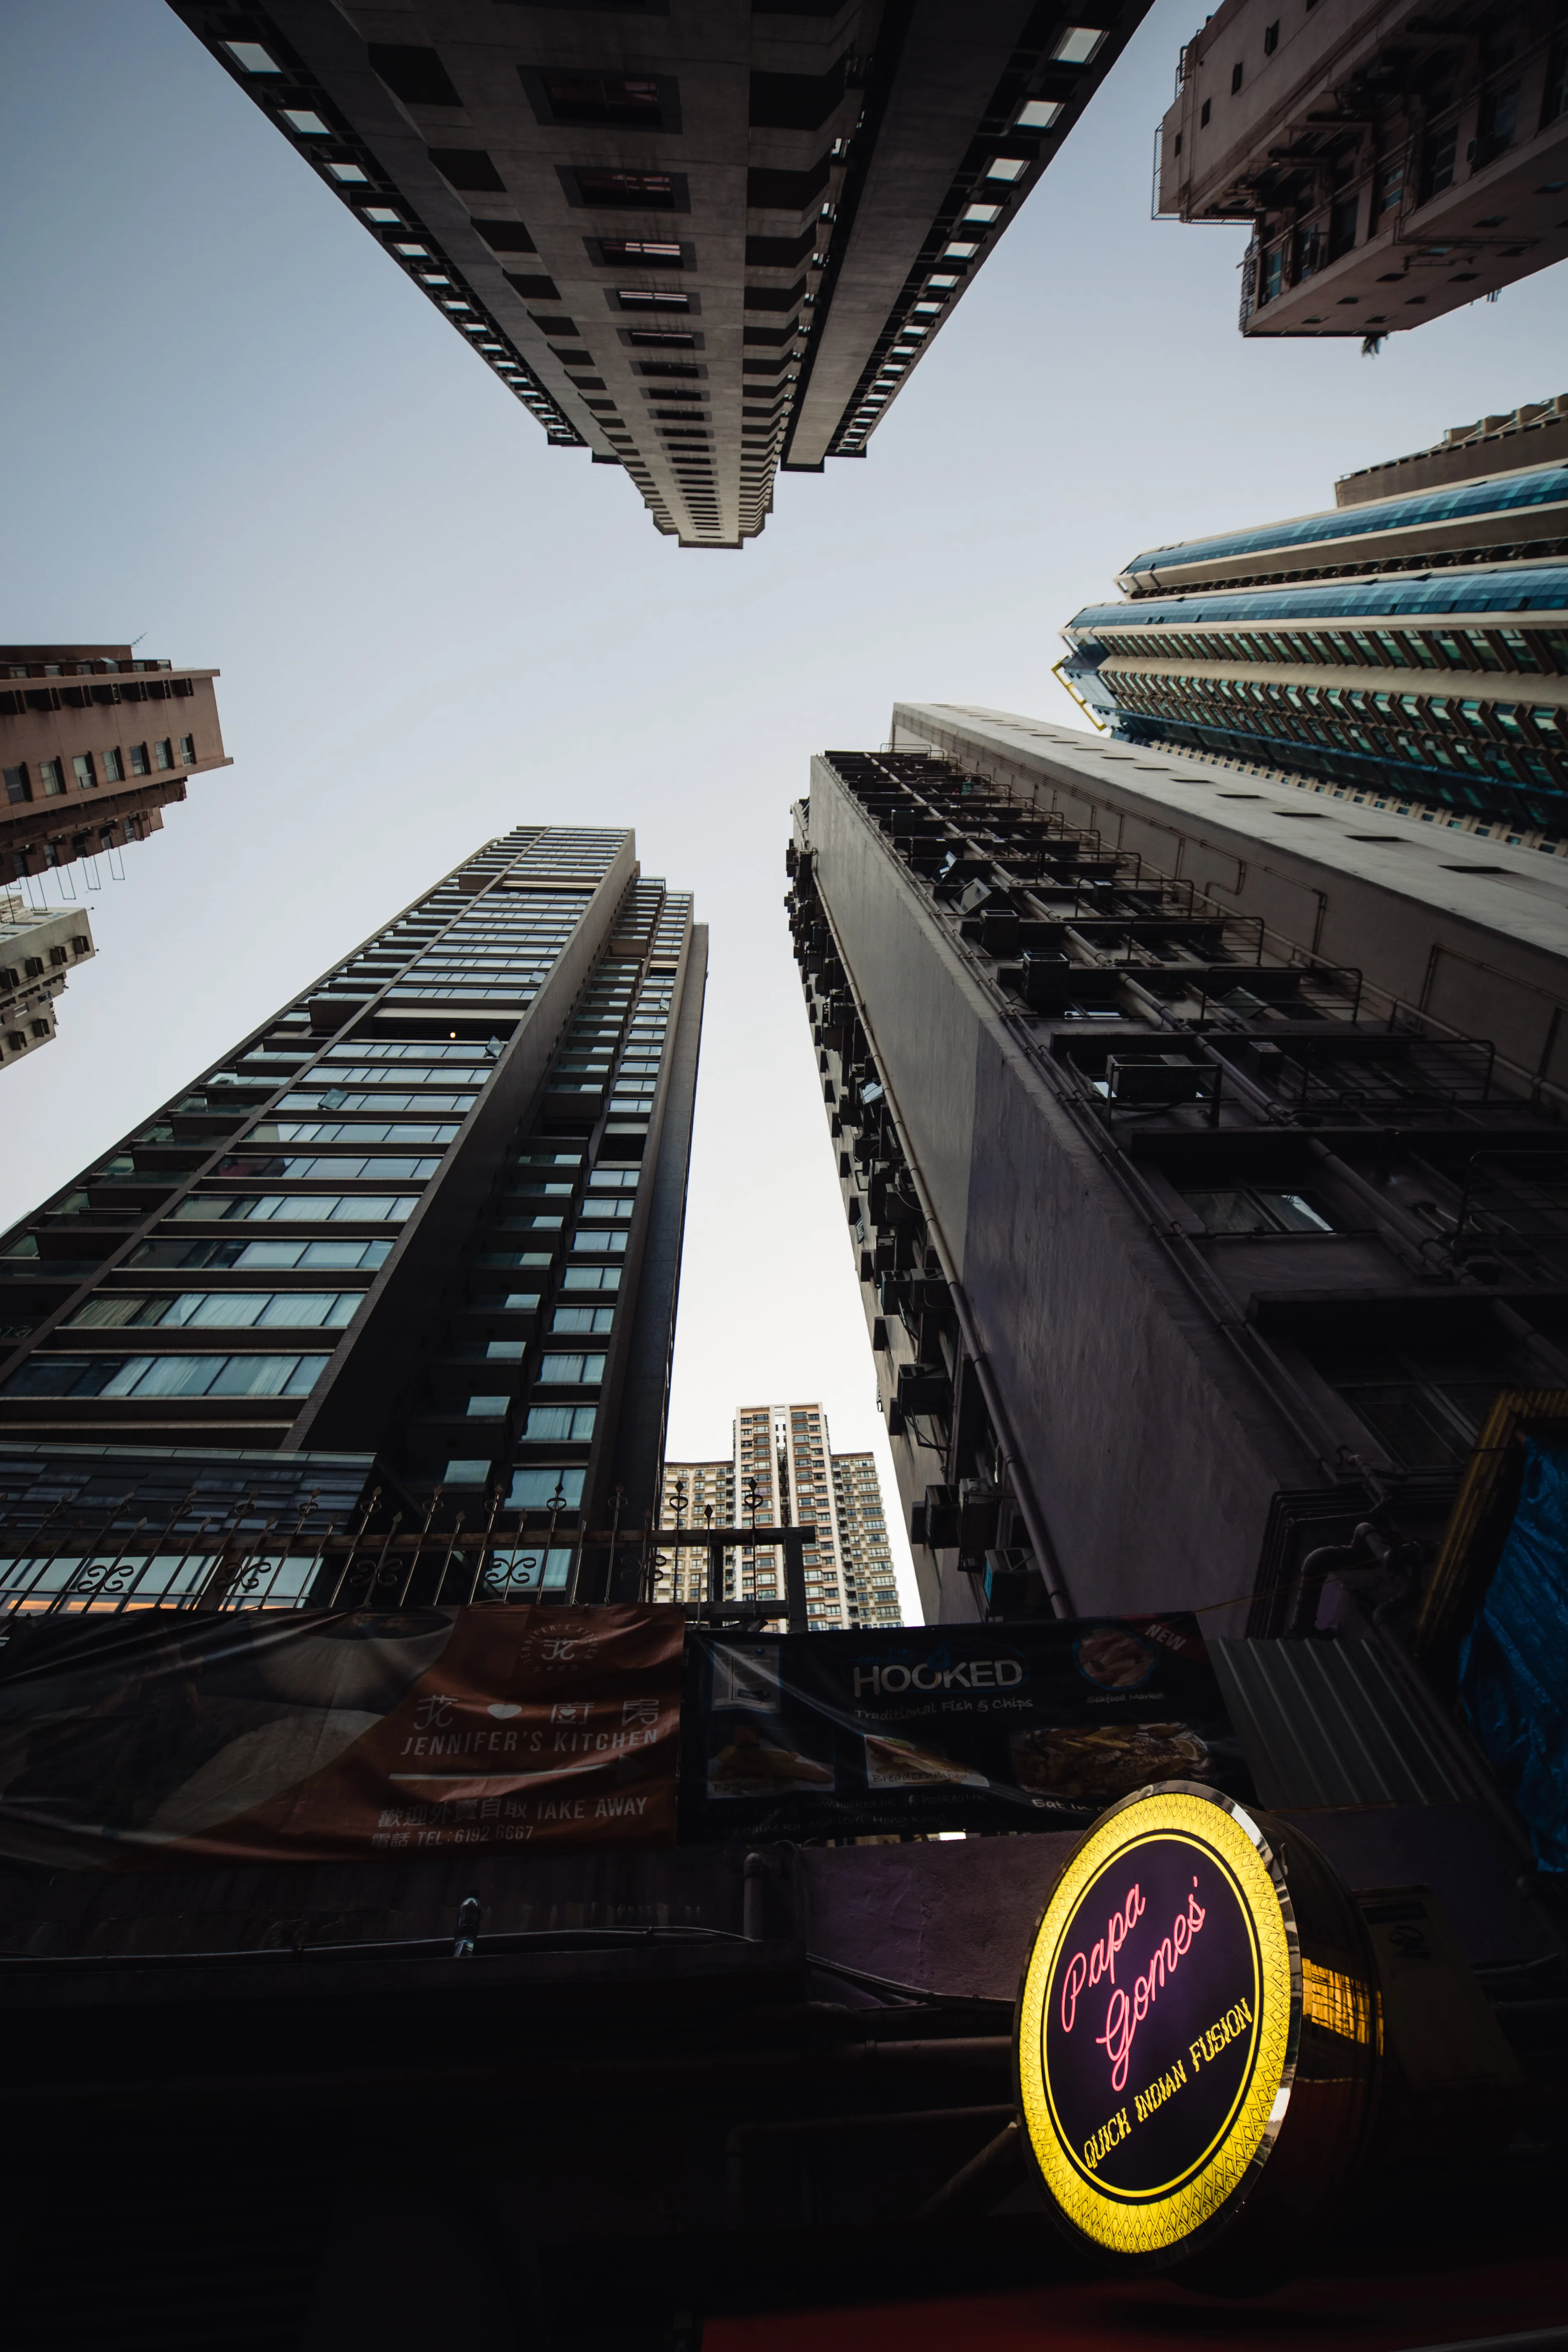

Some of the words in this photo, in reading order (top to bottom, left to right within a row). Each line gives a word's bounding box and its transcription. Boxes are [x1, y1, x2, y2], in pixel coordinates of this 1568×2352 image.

[521, 1624, 571, 1664] JENNIFER'S
[1145, 1624, 1188, 1651] NEW
[853, 1659, 1022, 1698] HOOKED
[855, 1702, 937, 1721] Traditional
[942, 1700, 972, 1712] Fish
[993, 1698, 1033, 1711] Chips
[1086, 1694, 1126, 1704] Seafood
[1129, 1692, 1165, 1700] Market
[401, 1731, 542, 1756] JENNIFER'S
[554, 1729, 658, 1752] KITCHEN
[378, 1797, 528, 1828] 歡迎外賣自取
[537, 1800, 585, 1819] TAKE
[595, 1797, 647, 1817] AWAY
[1031, 1799, 1066, 1809] Eat
[371, 1833, 409, 1849] 電話
[455, 1826, 489, 1842] 6192
[495, 1825, 534, 1840] 6667
[743, 1824, 778, 1834] Caine
[783, 1821, 800, 1831] Rd
[873, 1816, 906, 1827] Hong
[912, 1814, 945, 1825] Kong
[1061, 1883, 1146, 2032] Papa
[1083, 2108, 1131, 2169] QUICK
[1134, 2060, 1187, 2123] INDIAN
[1189, 1997, 1254, 2072] FUSION
